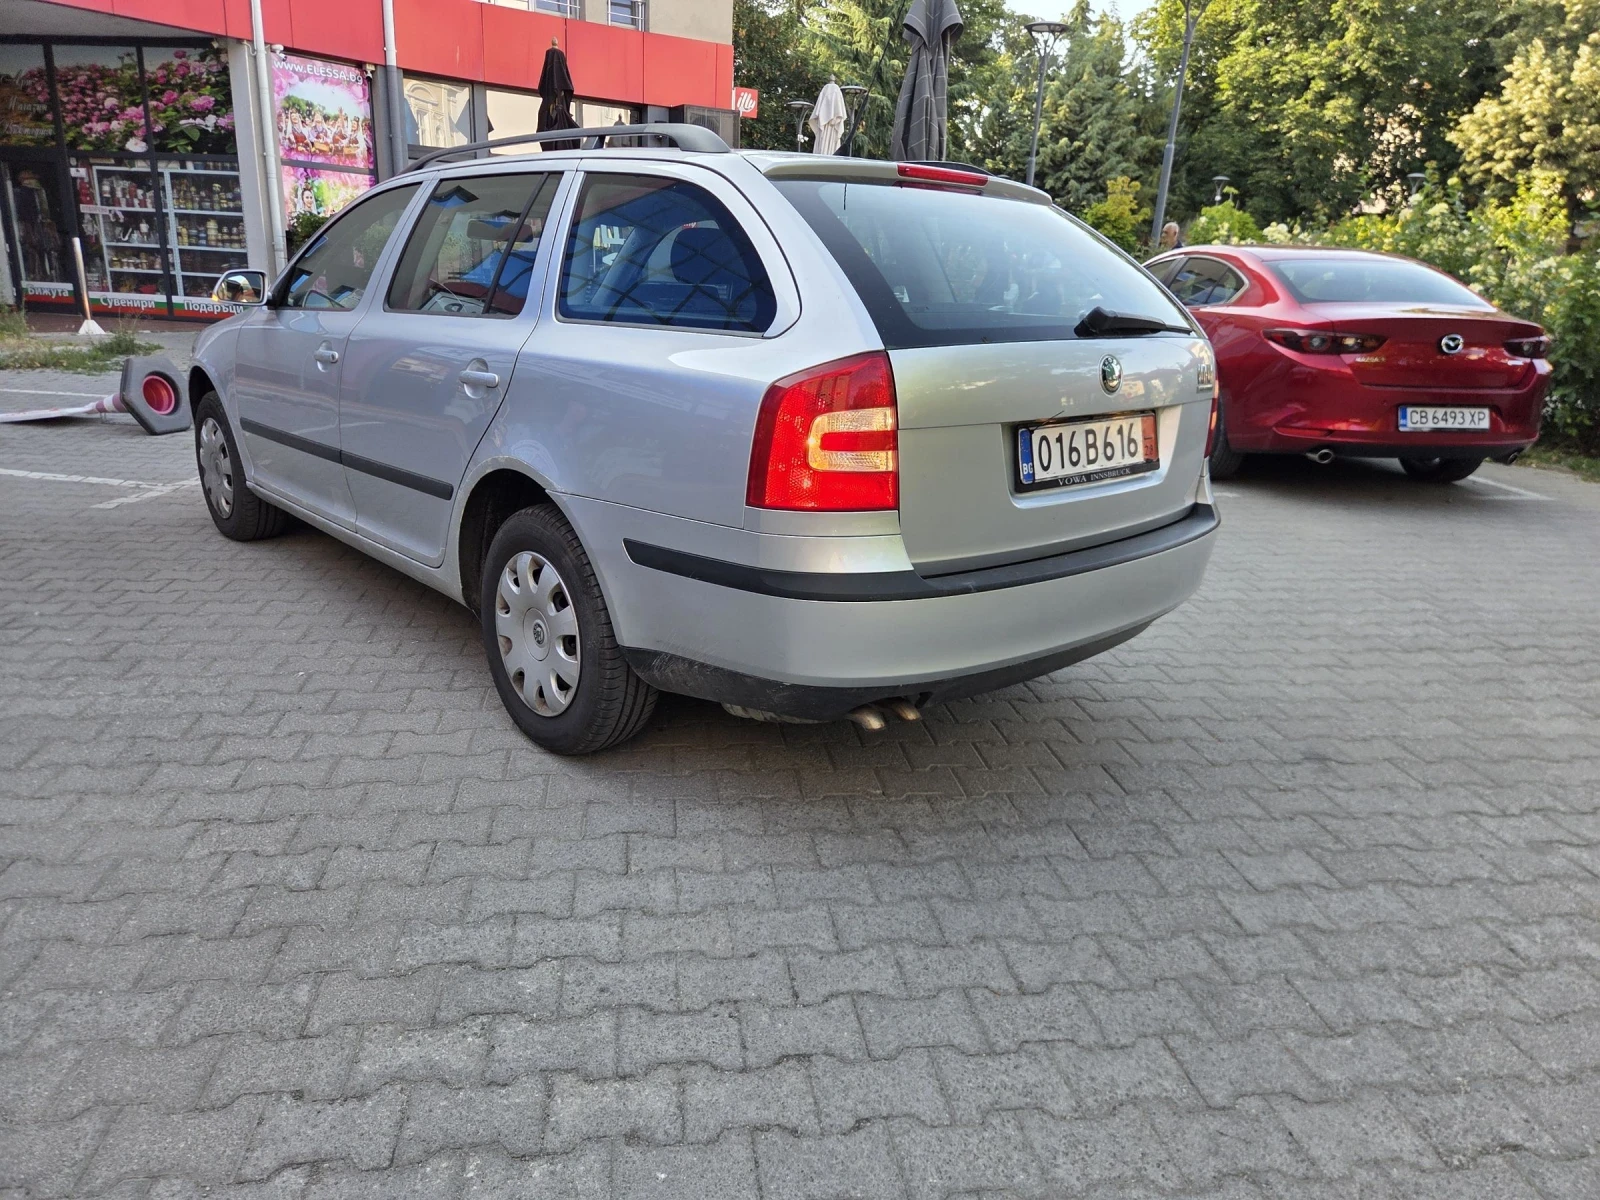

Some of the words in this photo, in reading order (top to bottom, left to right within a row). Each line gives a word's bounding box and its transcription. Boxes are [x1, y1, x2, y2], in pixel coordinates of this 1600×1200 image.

[273, 60, 363, 85] www.ELESSA.bg
[736, 91, 756, 113] illy
[100, 296, 155, 311] Сувенири
[184, 300, 244, 314] Подаръци
[1432, 410, 1465, 425] 6493
[1058, 475, 1087, 487] VOWA
[1090, 467, 1131, 481] INNSBRUCK
